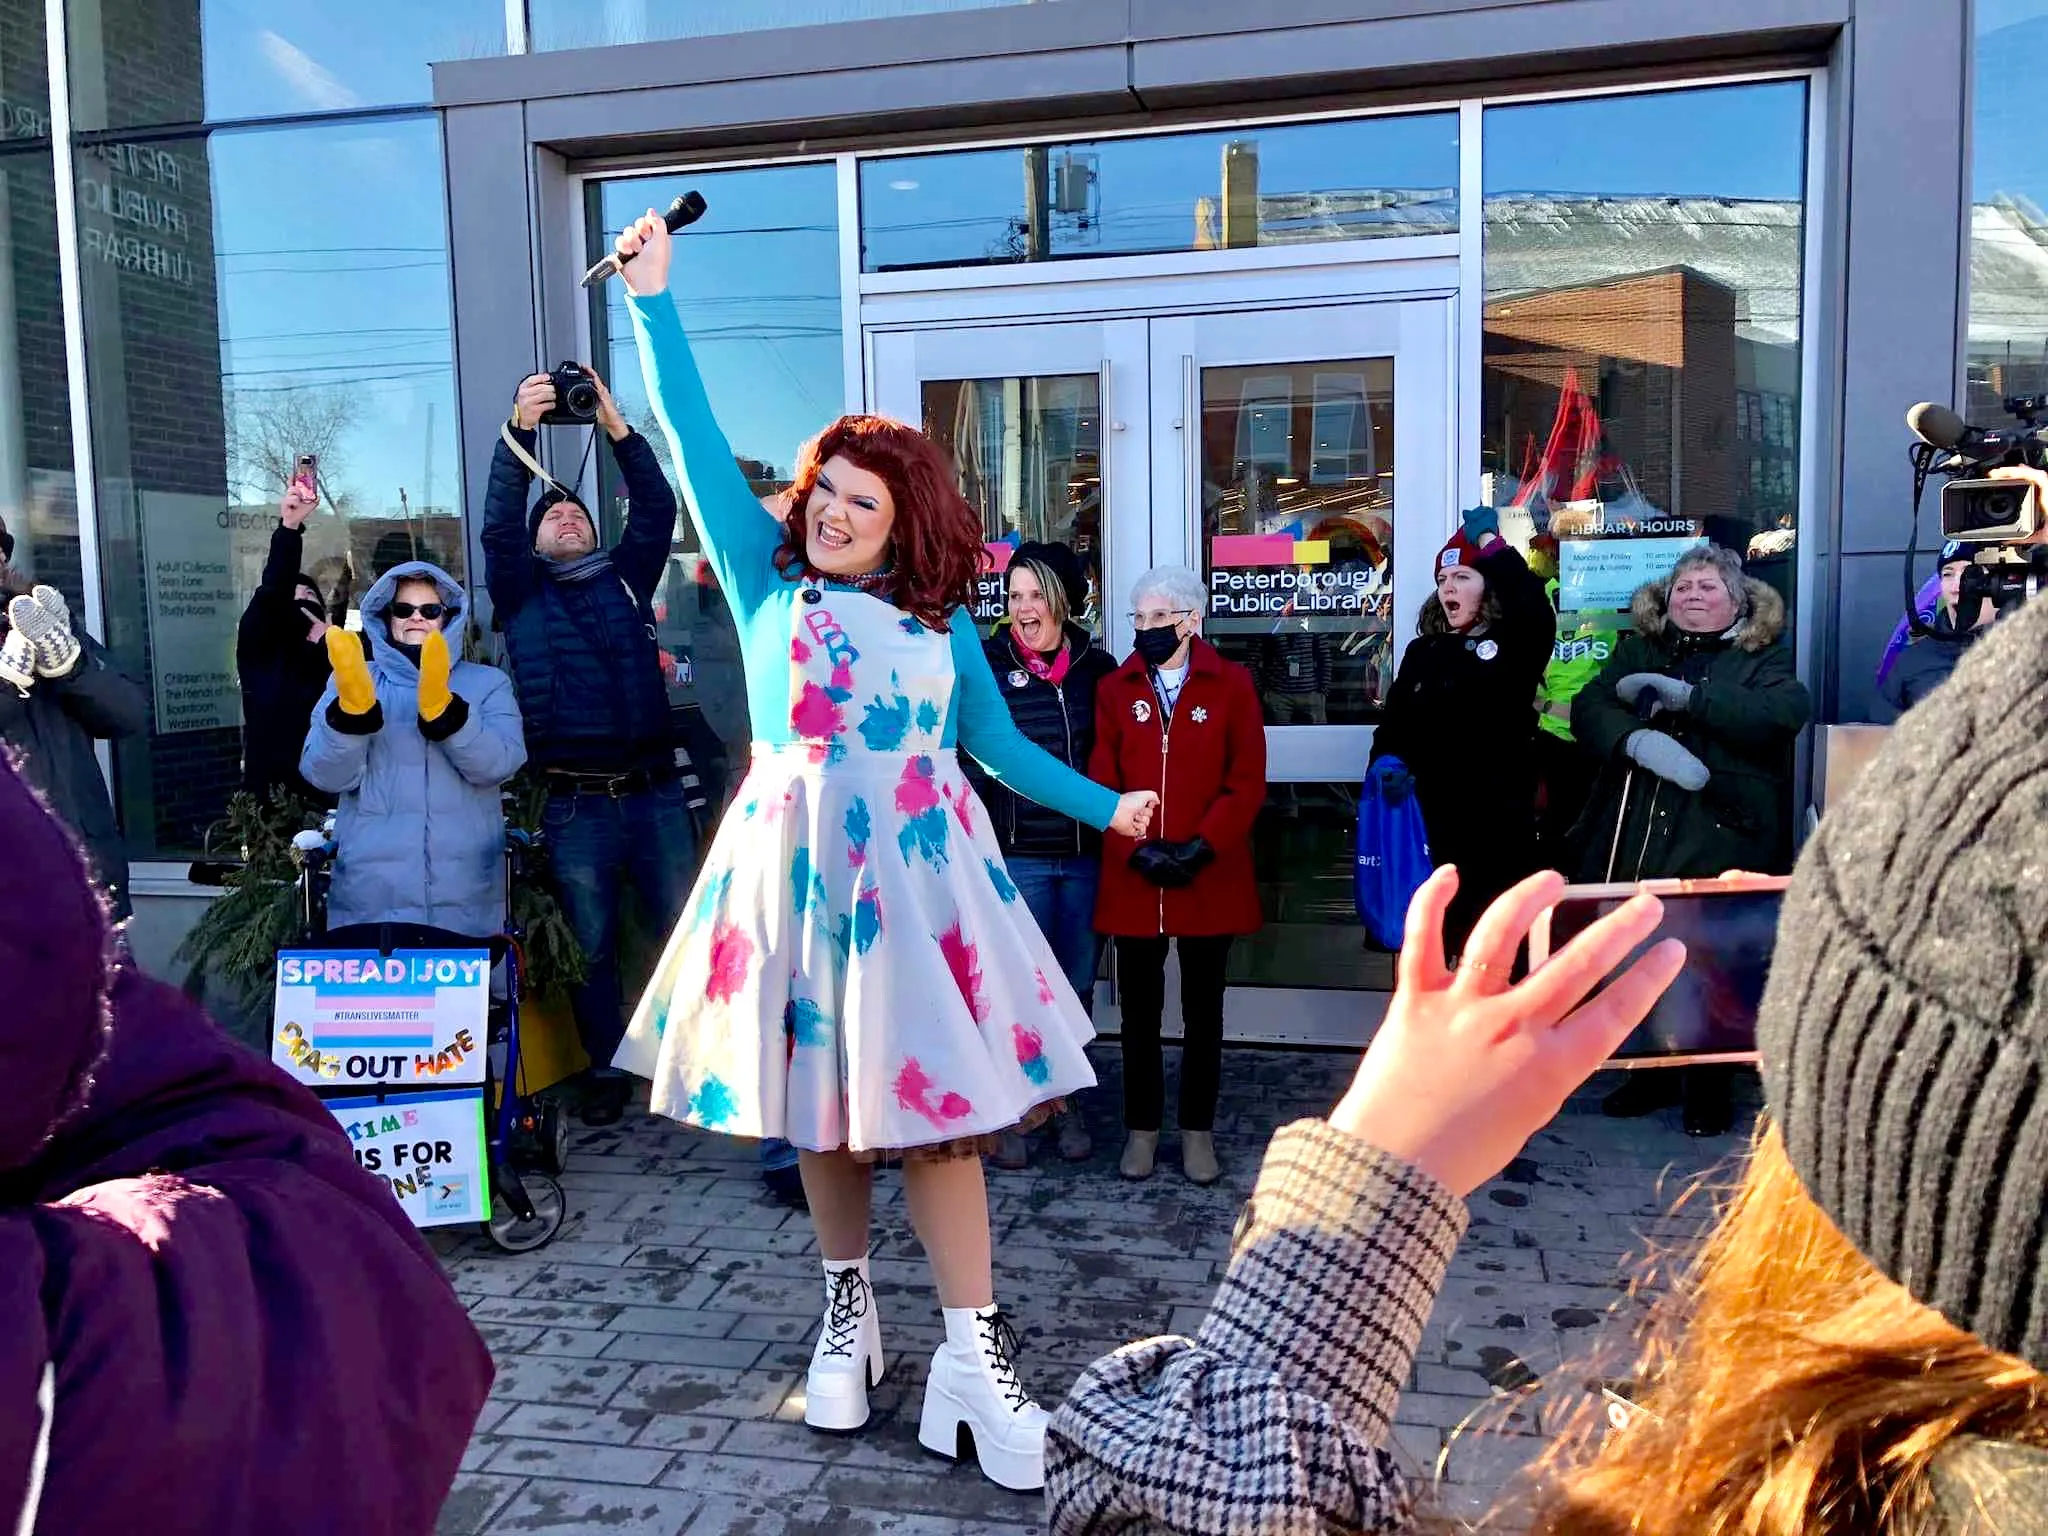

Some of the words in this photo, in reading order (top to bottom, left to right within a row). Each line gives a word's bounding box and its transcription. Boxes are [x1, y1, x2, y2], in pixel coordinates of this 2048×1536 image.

[216, 506, 281, 531] directo
[1570, 521, 1637, 536] LIBRARY
[1640, 520, 1696, 533] HOURS
[156, 560, 180, 572] Adult
[182, 561, 227, 574] Collection
[1573, 553, 1600, 562] Monday
[1610, 552, 1632, 561] Friday
[1211, 567, 1383, 593] Peterborough
[159, 605, 184, 617] Study
[1211, 593, 1284, 612] Public
[1293, 592, 1383, 612] Library
[283, 959, 406, 985] SPREAD
[418, 959, 480, 984] JOY
[334, 1011, 420, 1021] #TRANSLIVESMATTER
[278, 1021, 341, 1079] DRAG
[346, 1055, 408, 1078] OUT
[415, 1028, 475, 1077] HATE
[346, 1109, 419, 1141] TIME
[393, 1141, 452, 1167] FOR
